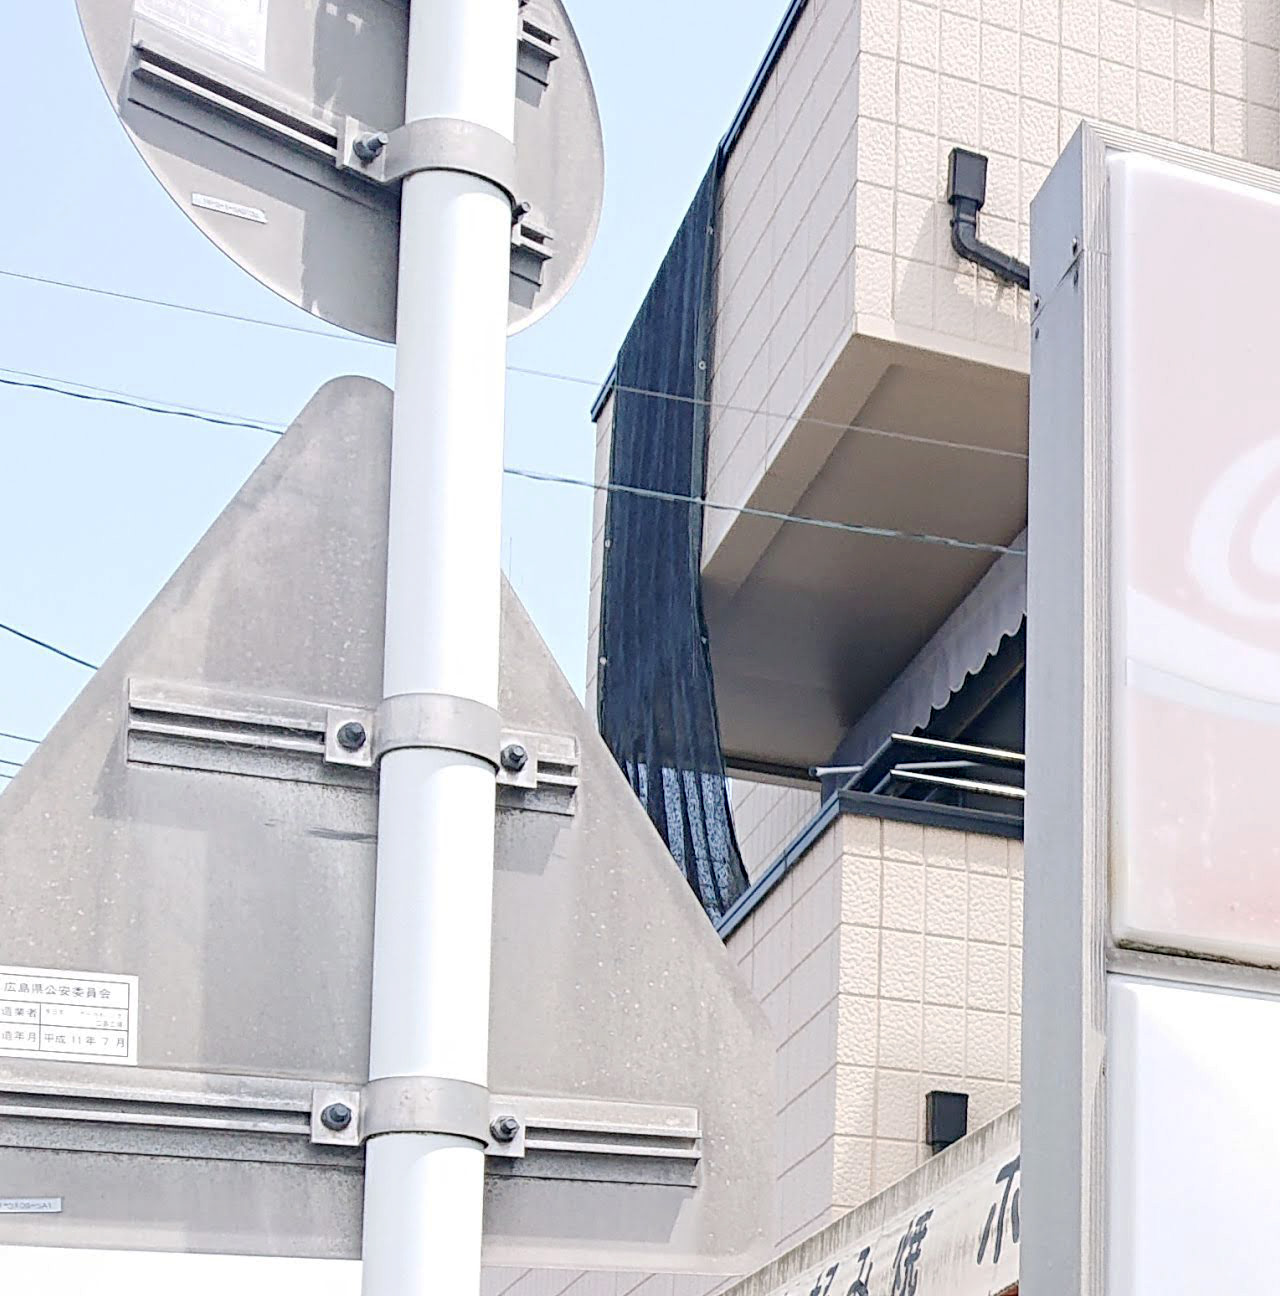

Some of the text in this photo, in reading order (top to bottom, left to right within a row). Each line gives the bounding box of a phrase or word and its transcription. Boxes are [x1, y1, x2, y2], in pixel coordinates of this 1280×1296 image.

[4, 981, 111, 999] 広島県公安委員会
